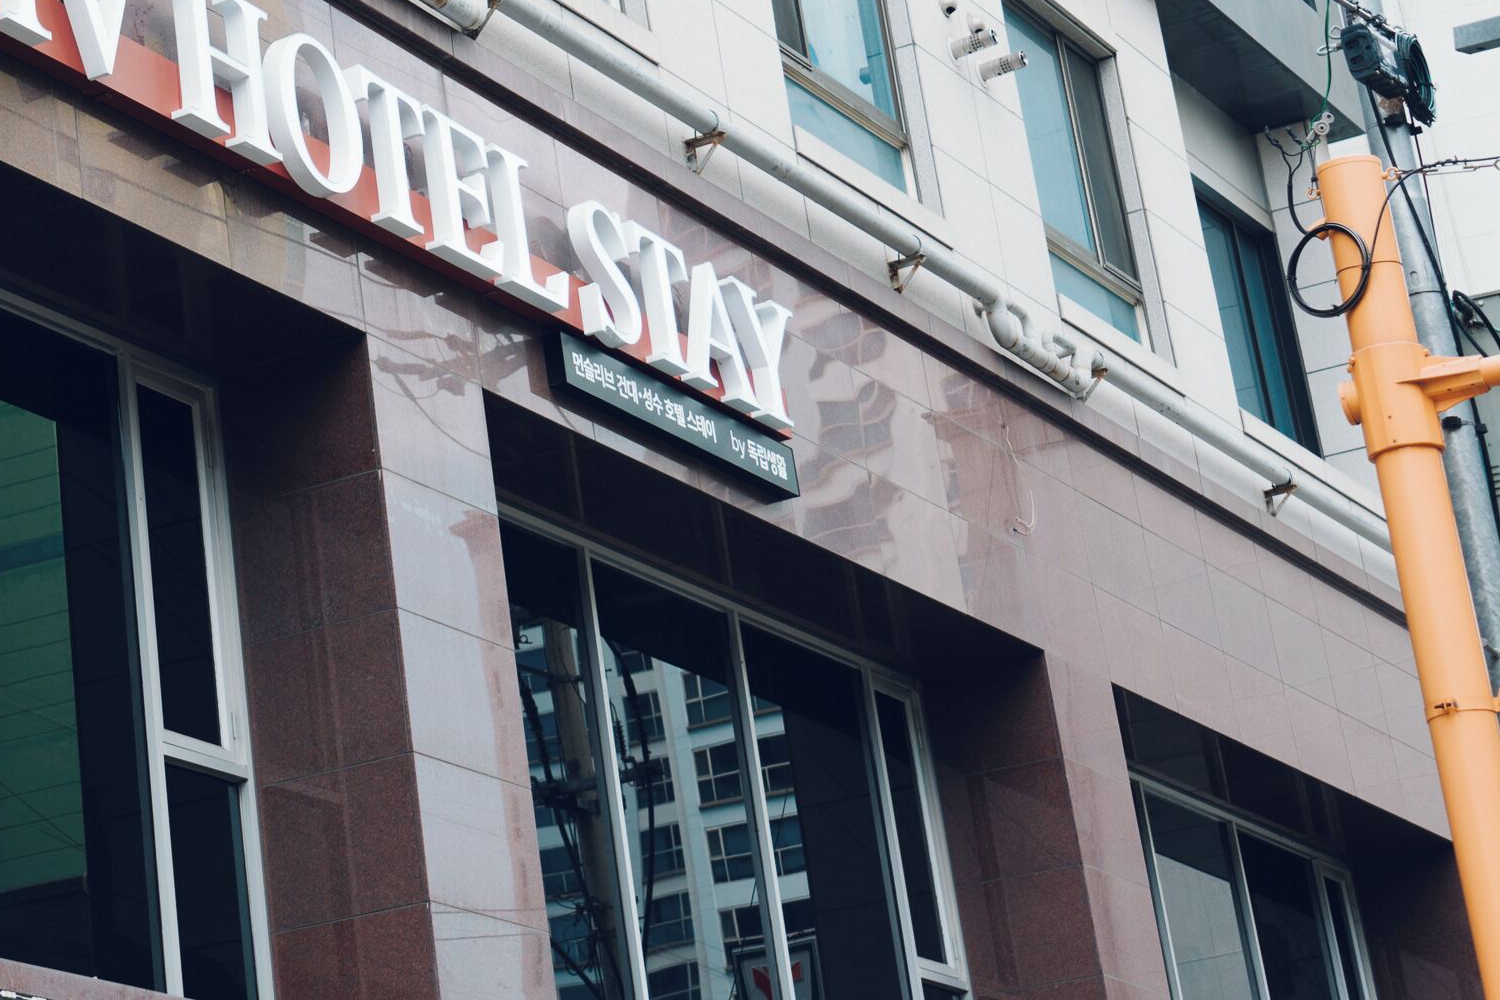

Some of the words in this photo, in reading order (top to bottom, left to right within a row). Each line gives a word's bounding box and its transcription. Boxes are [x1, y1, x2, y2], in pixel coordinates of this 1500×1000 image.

[566, 200, 794, 430] STAY
[572, 352, 616, 391] 먼슬리브
[665, 398, 686, 429] 호텔
[687, 410, 717, 444] 스테이
[730, 430, 746, 459] by
[747, 439, 788, 480] 독립생활
